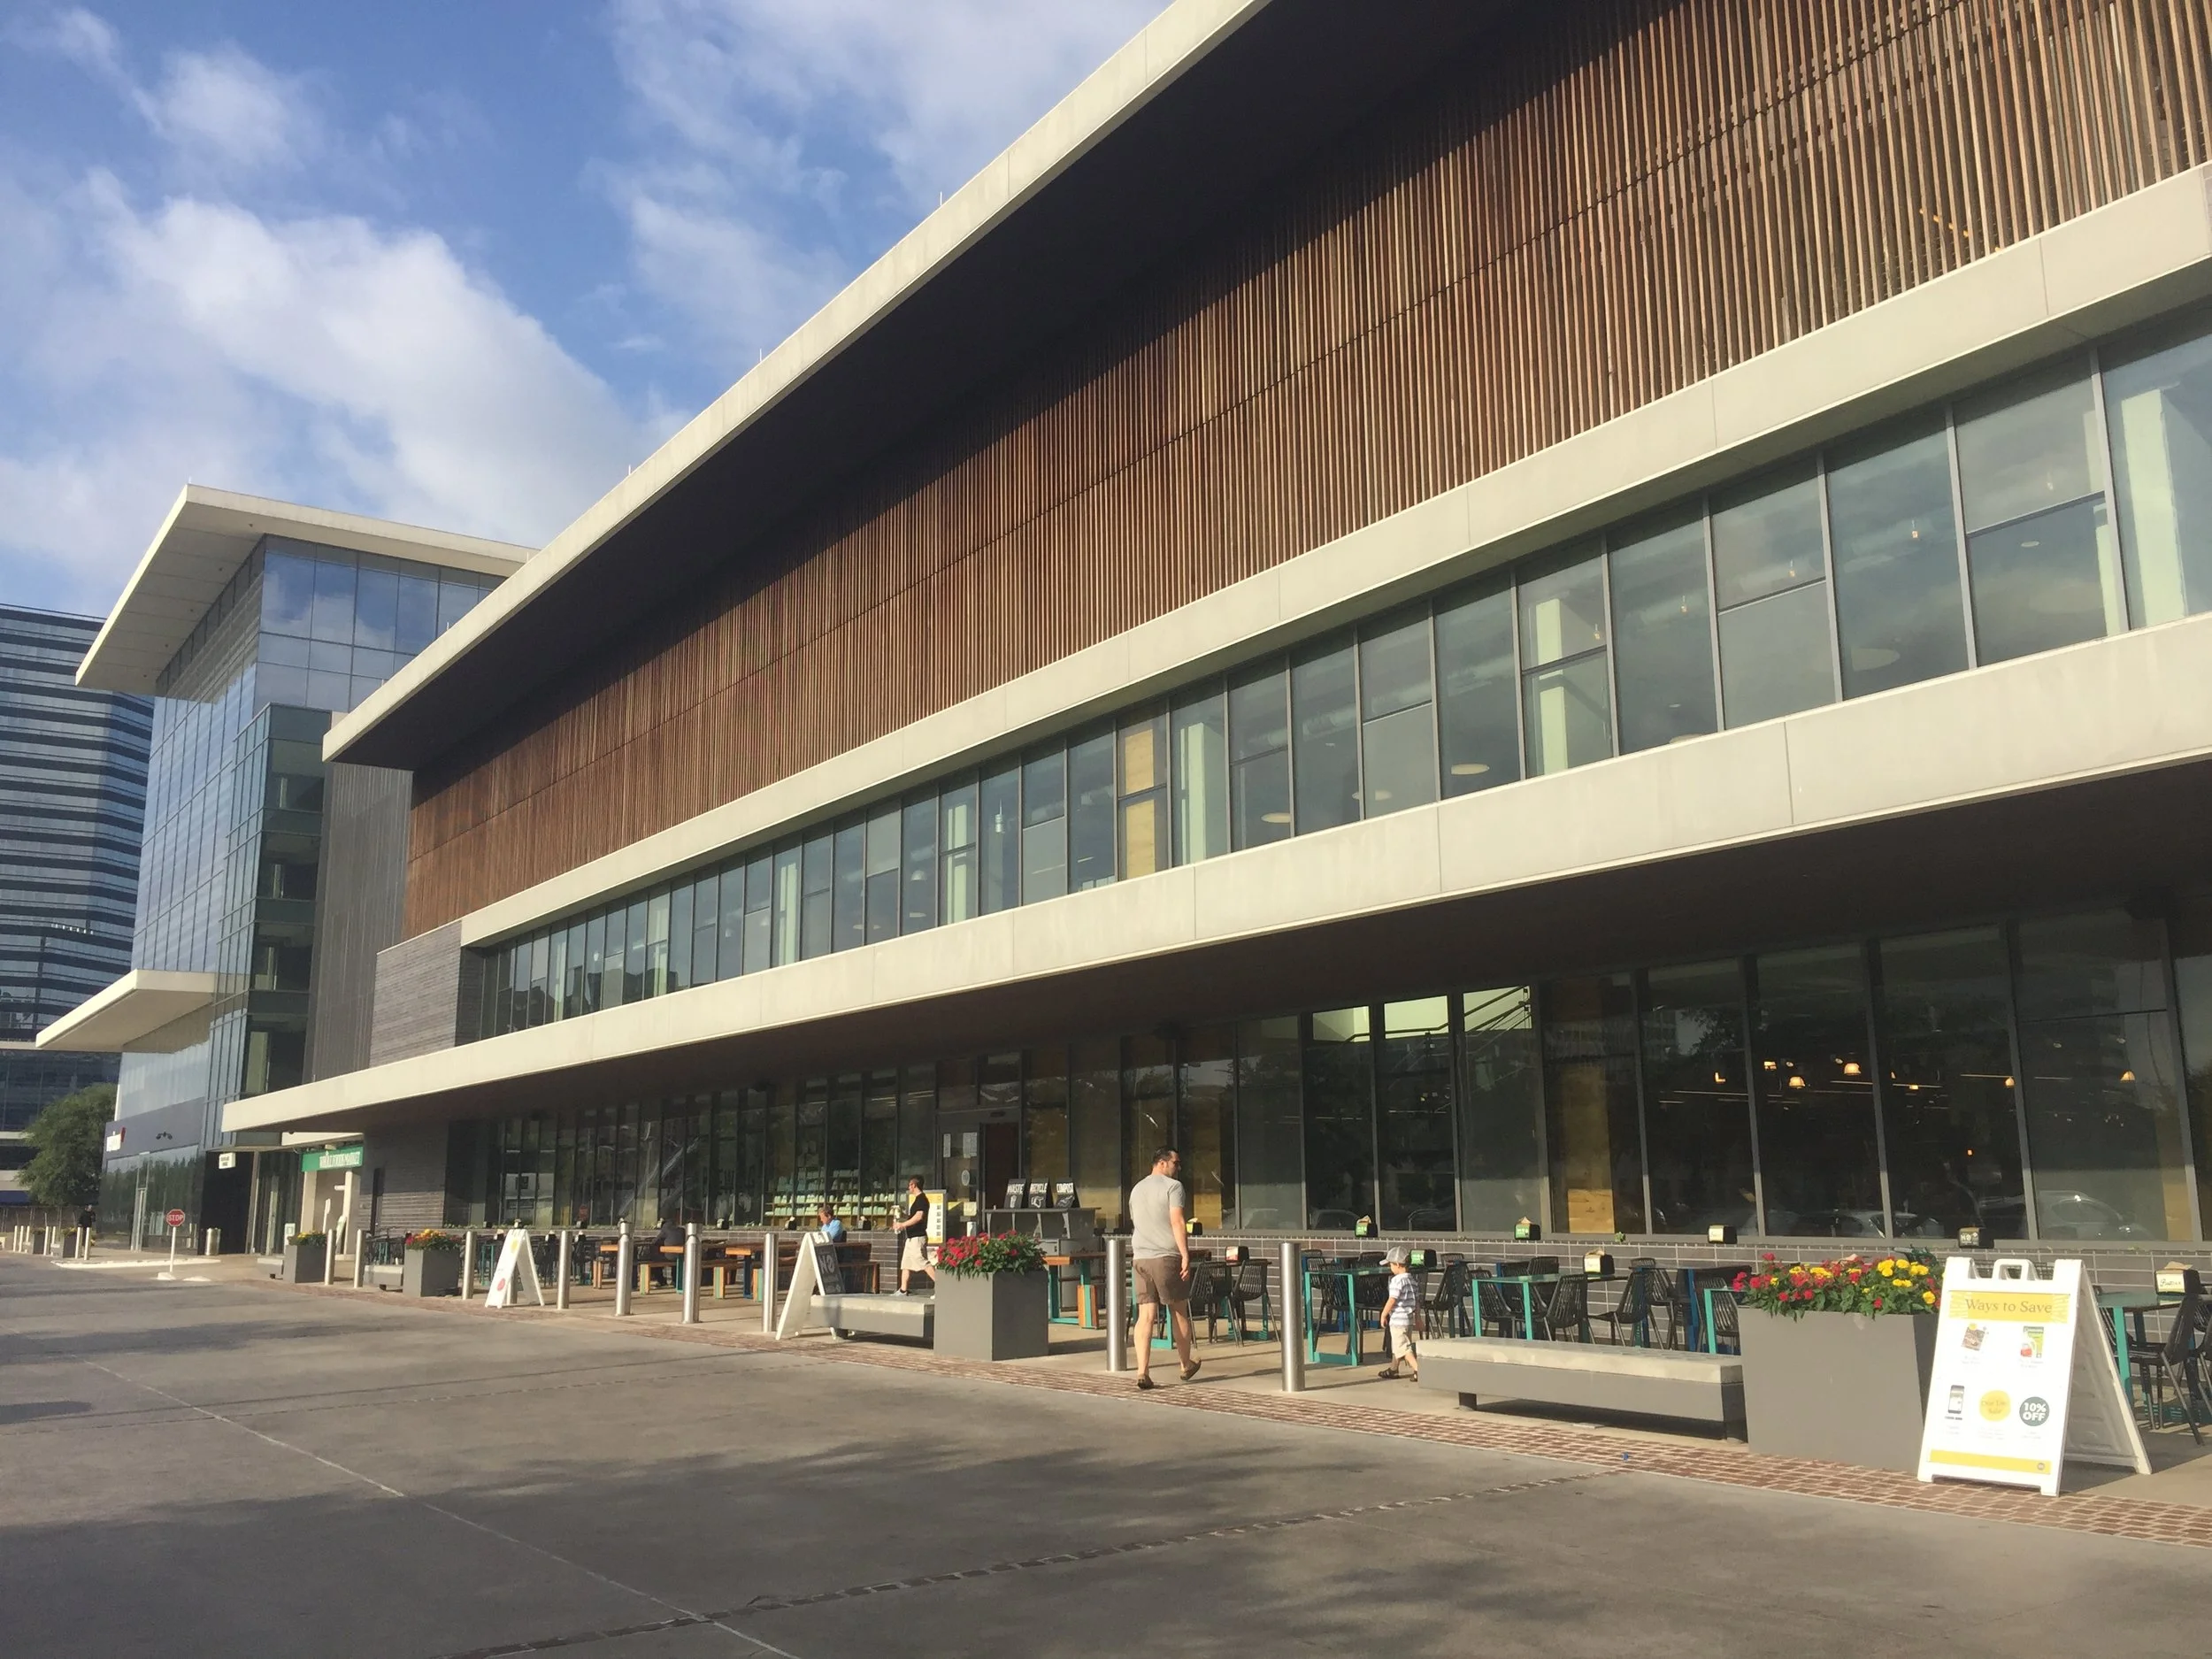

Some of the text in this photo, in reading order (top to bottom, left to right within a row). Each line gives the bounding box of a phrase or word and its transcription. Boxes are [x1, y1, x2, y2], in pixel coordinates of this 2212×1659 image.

[1007, 1183, 1025, 1194] WASTE
[1029, 1182, 1048, 1194] RECYCLE
[1965, 1298, 2053, 1314] Ways to Save
[2024, 1402, 2047, 1413] 10%
[2022, 1411, 2047, 1421] OFF
